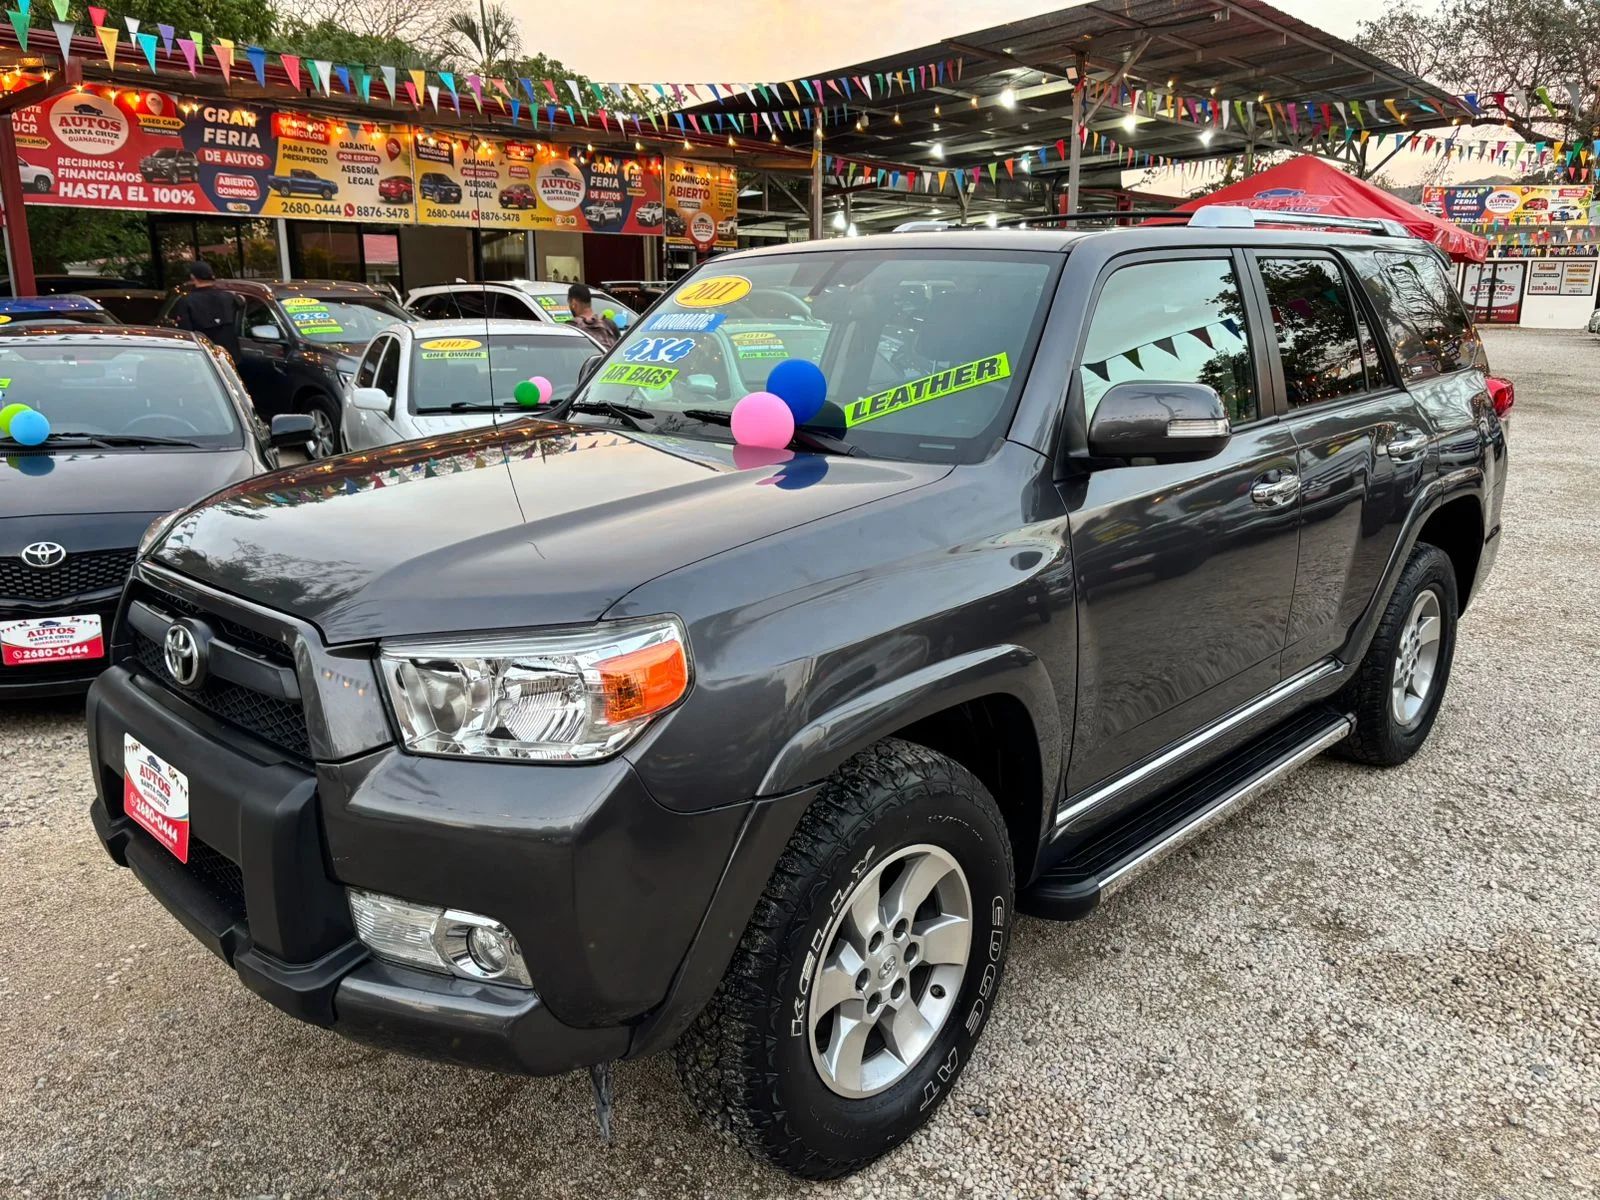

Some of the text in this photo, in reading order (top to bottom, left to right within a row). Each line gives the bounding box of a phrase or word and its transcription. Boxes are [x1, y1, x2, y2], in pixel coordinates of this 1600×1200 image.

[22, 113, 36, 122] LA
[59, 116, 122, 132] AUTOS
[204, 107, 256, 128] GRAN
[13, 122, 37, 134] UCR
[62, 128, 120, 139] SANTA CRUZ
[68, 136, 115, 146] GUANACASTE
[204, 128, 260, 148] FERIA
[282, 144, 328, 156] PARA TODO
[339, 141, 376, 152] GARANTÍA
[58, 157, 124, 170] RECIBIMOS Y
[205, 150, 264, 167] DE AUTOS
[282, 153, 328, 164] PRESUPUESTO
[463, 157, 495, 168] GARANTÍA
[342, 164, 380, 175] ASESORÍA
[591, 162, 618, 174] GRAN
[58, 170, 142, 183] FINANCIAMOS
[219, 176, 254, 188] ABIERTO
[348, 176, 375, 186] LEGAL
[590, 176, 620, 188] FERIA
[670, 173, 710, 186] DOMINGOS
[464, 180, 498, 189] ASESORÍA
[542, 179, 582, 191] AUTOS
[59, 182, 196, 205] HASTA EL 100%
[217, 186, 258, 197] DOMINGOS
[470, 190, 493, 199] LEGAL
[590, 190, 599, 198] DE
[600, 192, 620, 200] AUTOS
[669, 185, 711, 200] ABIERTO
[281, 202, 410, 218] 2680-0444 8876-5478
[427, 208, 520, 222] 2680-0444 8876-5478
[682, 282, 741, 300] 2011
[1470, 284, 1516, 292] AUTOS
[650, 313, 716, 330] AUTOMATIC
[432, 340, 472, 349] 2007
[623, 338, 695, 362] 4X4
[602, 366, 672, 385] AIR BAGS
[851, 357, 1001, 421] LEATHER
[27, 627, 76, 638] AUTOS
[23, 645, 89, 659] 2680-0444
[140, 764, 171, 797] AUTOS
[140, 779, 170, 806] SANTA CRUZ
[136, 798, 178, 843] 2680-0444
[791, 846, 876, 1037] KELLY
[920, 895, 1005, 1112] EDGE AT
